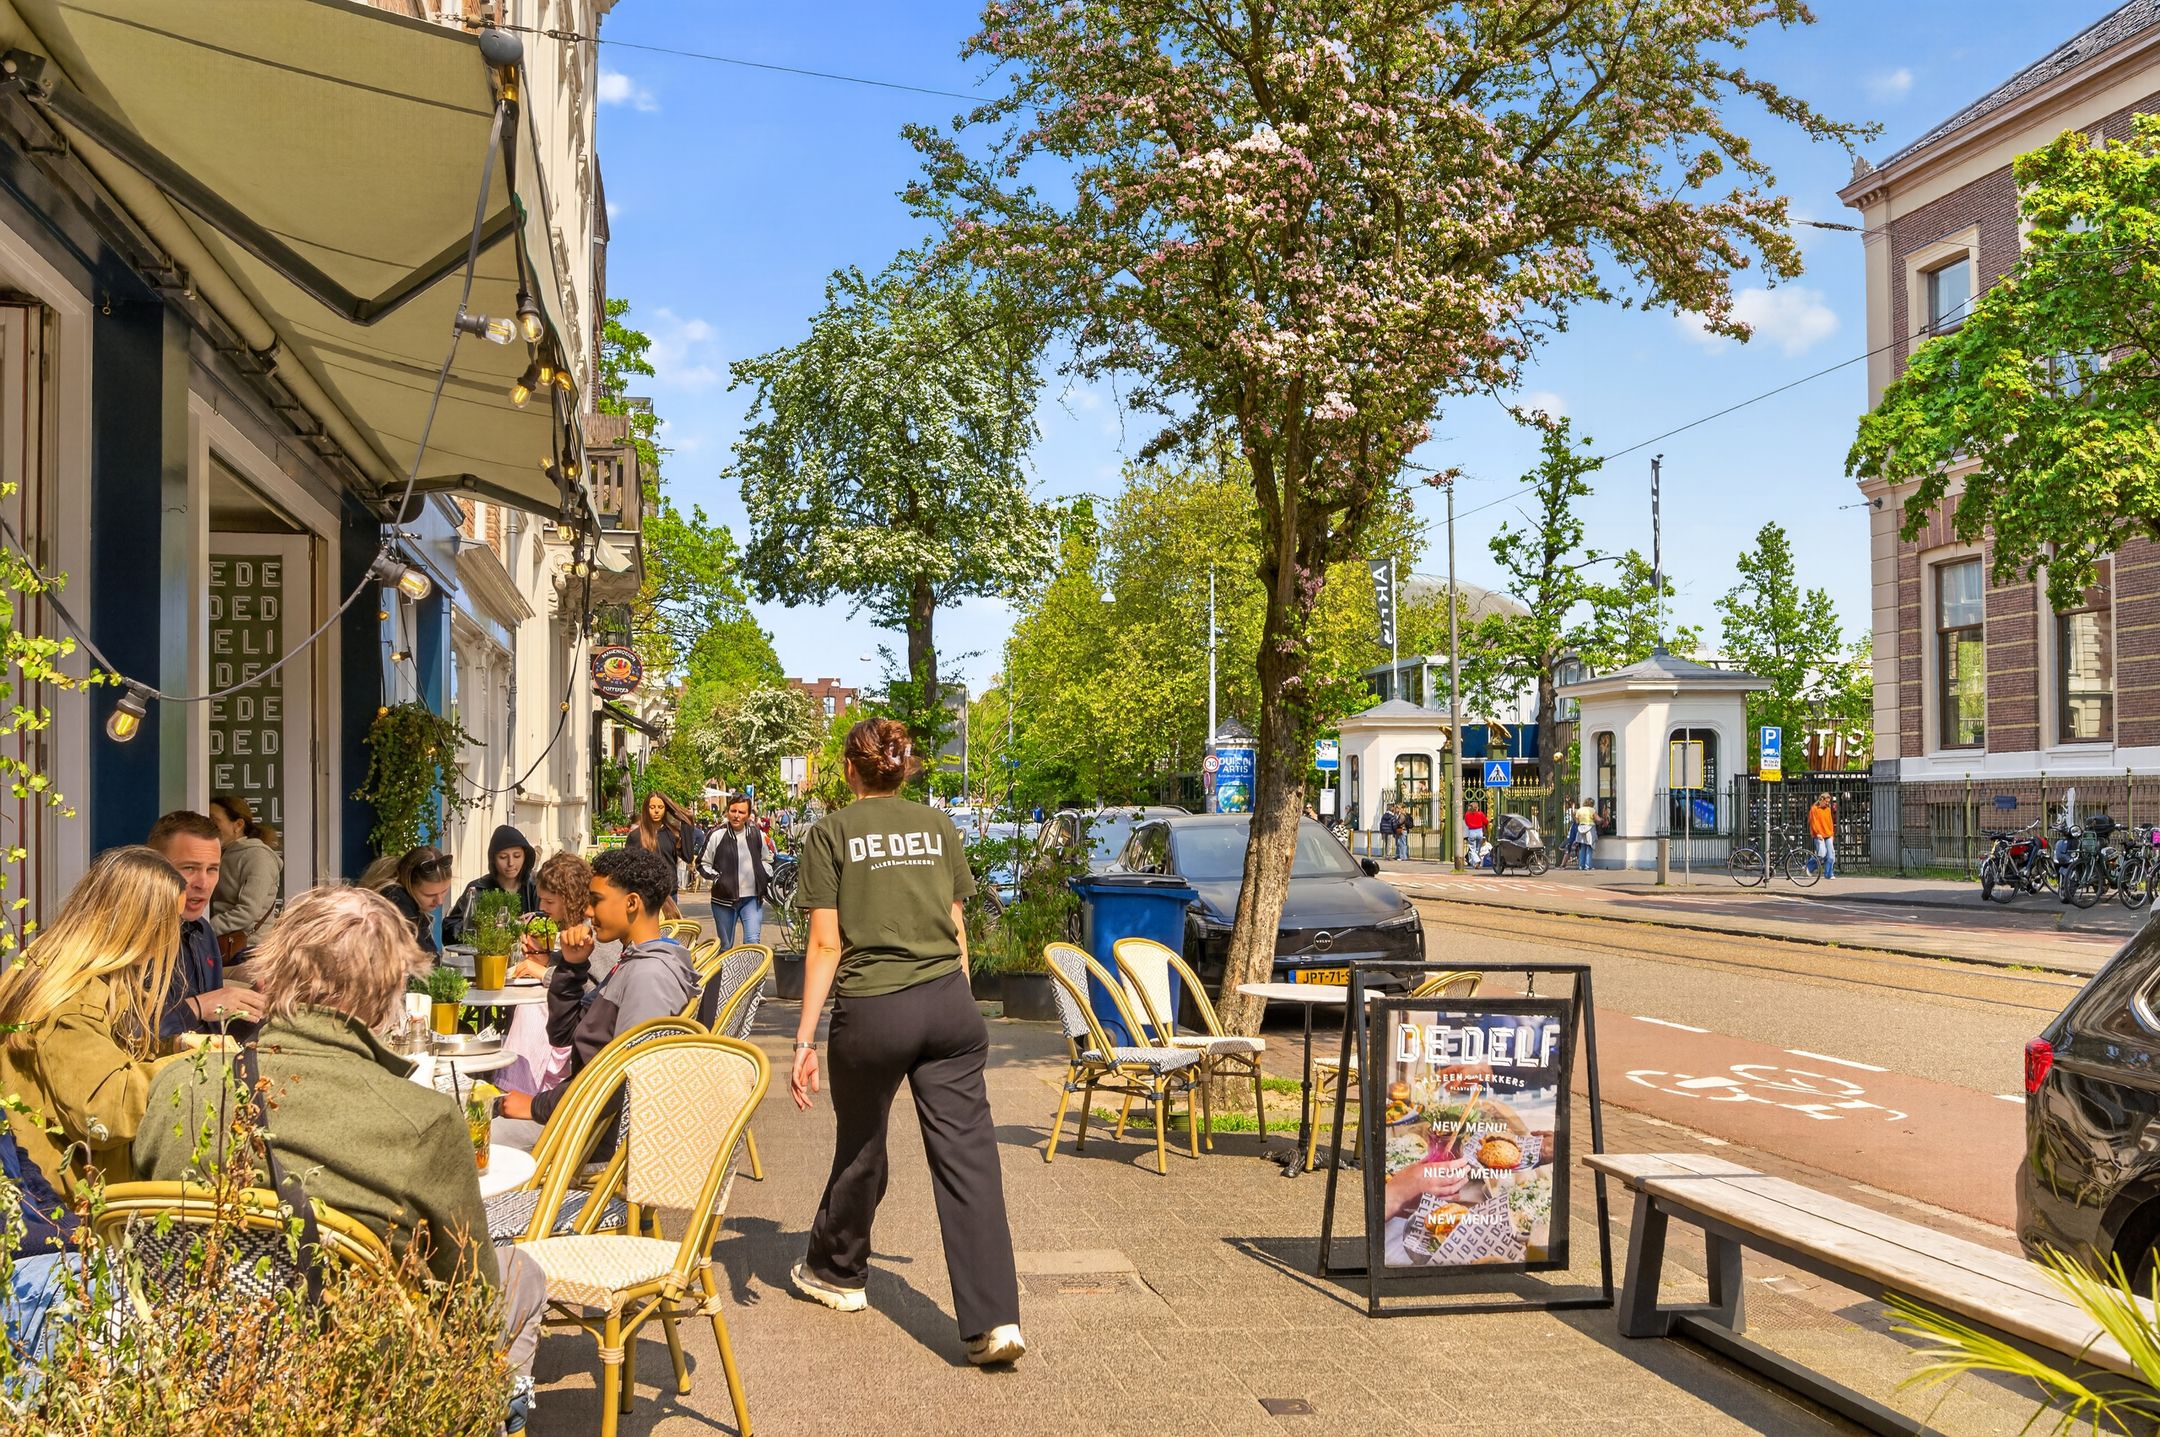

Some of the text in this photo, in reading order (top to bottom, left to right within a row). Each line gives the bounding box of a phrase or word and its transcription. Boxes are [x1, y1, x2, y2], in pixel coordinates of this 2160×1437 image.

[1765, 729, 1777, 745] P
[1223, 765, 1249, 773] ARTIS
[849, 832, 942, 862] DE DELI
[1422, 1073, 1463, 1084] ALLEEN
[1479, 1073, 1526, 1088] LEKKERS
[1432, 1121, 1508, 1133] NEW MENU!
[1423, 1167, 1513, 1180] NIEUW MENU!
[1427, 1213, 1503, 1225] NEW MENU!
